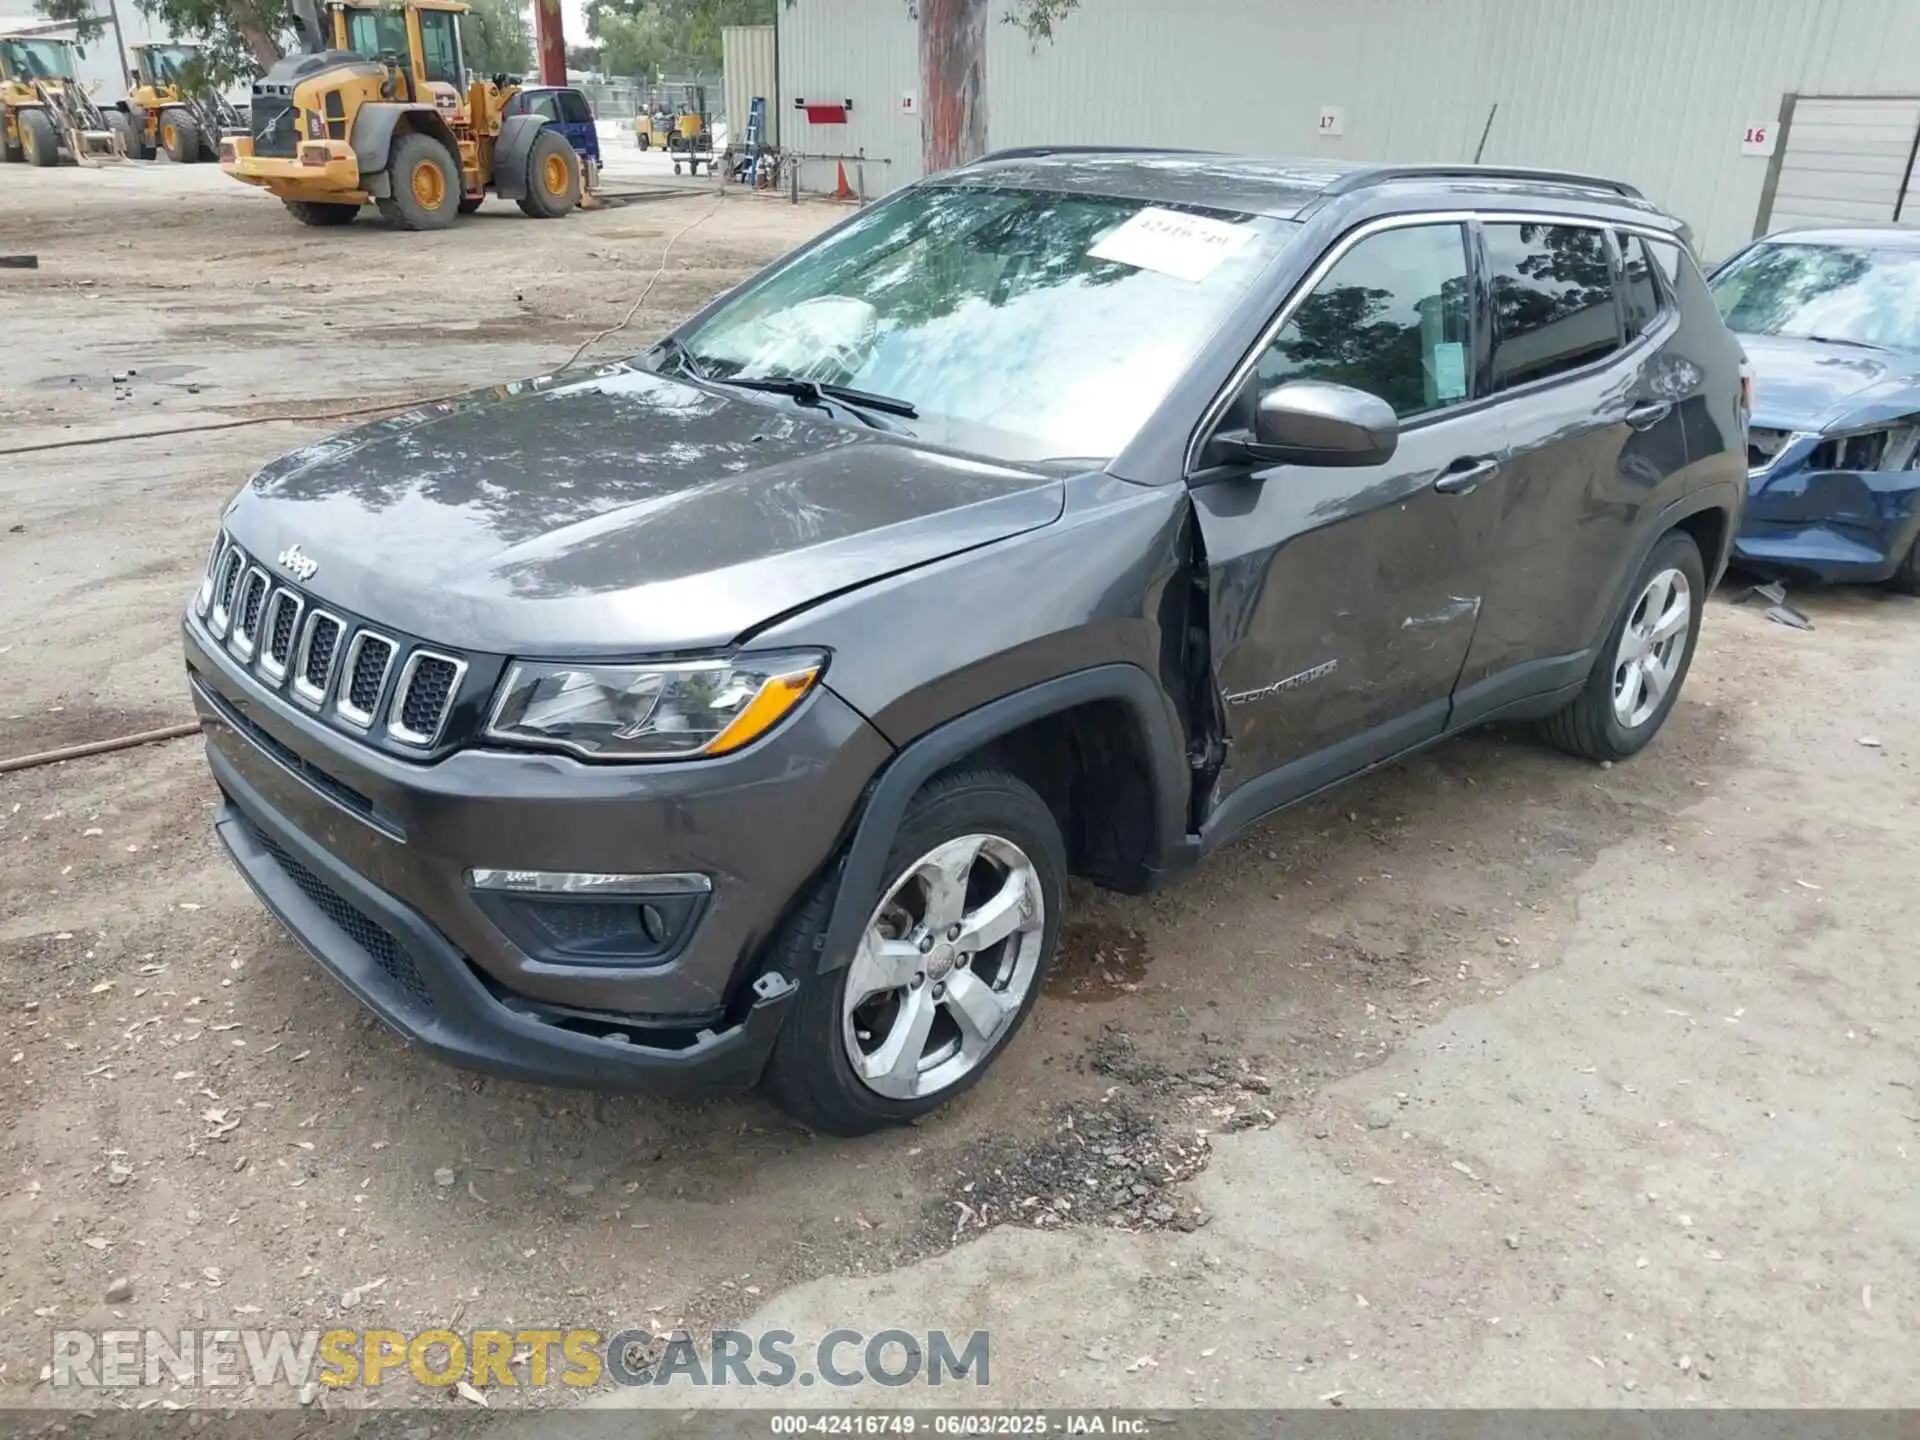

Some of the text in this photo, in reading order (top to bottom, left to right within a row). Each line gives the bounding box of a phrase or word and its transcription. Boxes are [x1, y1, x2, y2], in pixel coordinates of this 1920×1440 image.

[1319, 116, 1335, 128] 17
[1744, 128, 1766, 143] 16
[277, 543, 319, 581] Jeep
